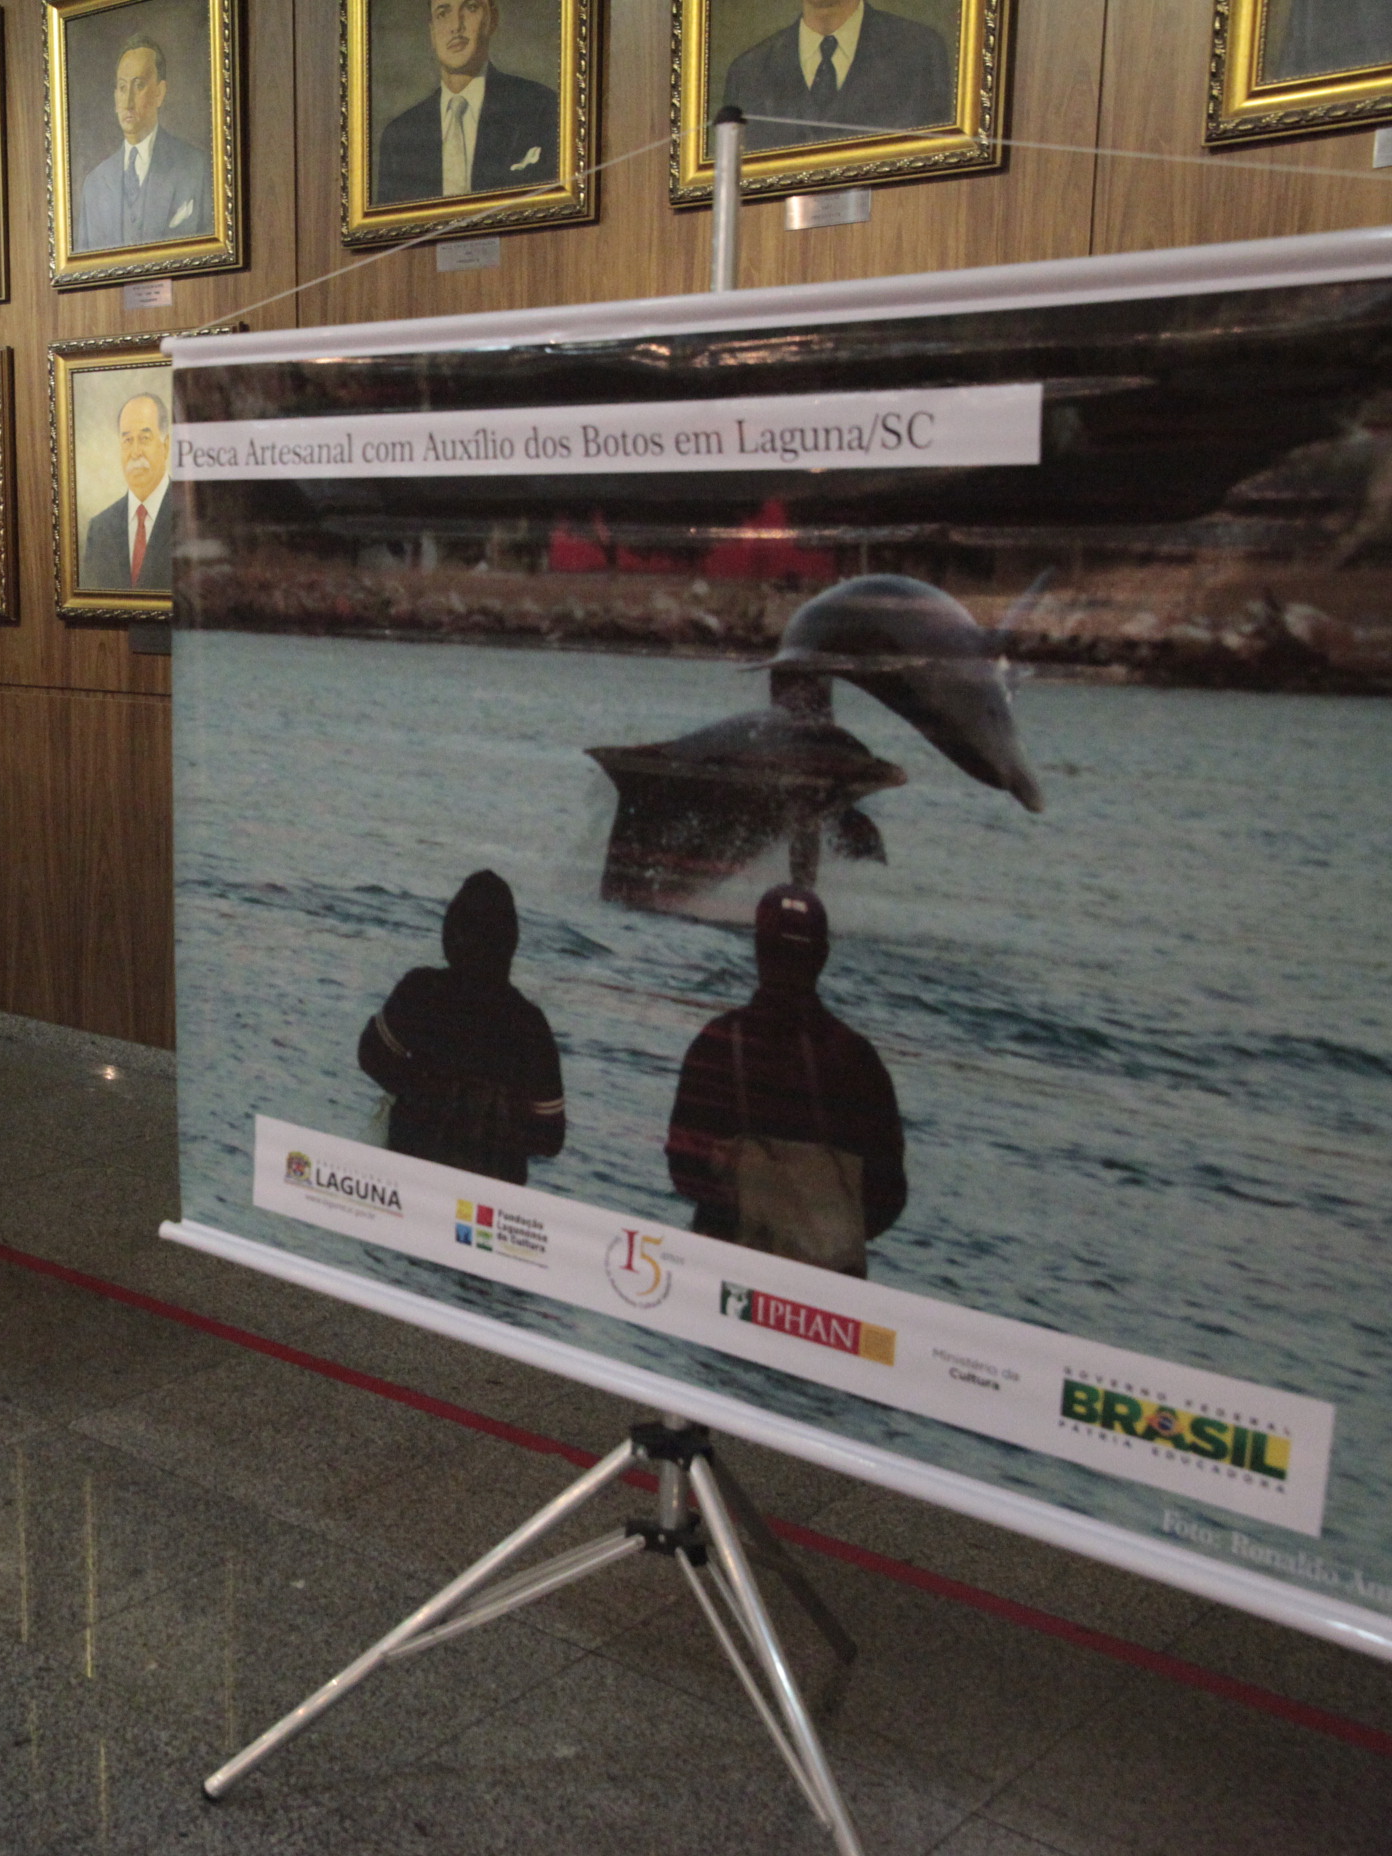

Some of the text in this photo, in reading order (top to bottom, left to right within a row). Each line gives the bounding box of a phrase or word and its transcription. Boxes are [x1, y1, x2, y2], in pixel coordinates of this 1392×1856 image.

[175, 411, 936, 469] Pesca Artesanal com Auxílio dos Botos em Laguna/SC
[315, 1167, 403, 1211] LAGUNA
[755, 1295, 857, 1351] IPHAN
[949, 1366, 1000, 1391] Cultura
[1060, 1377, 1288, 1481] BRASIL
